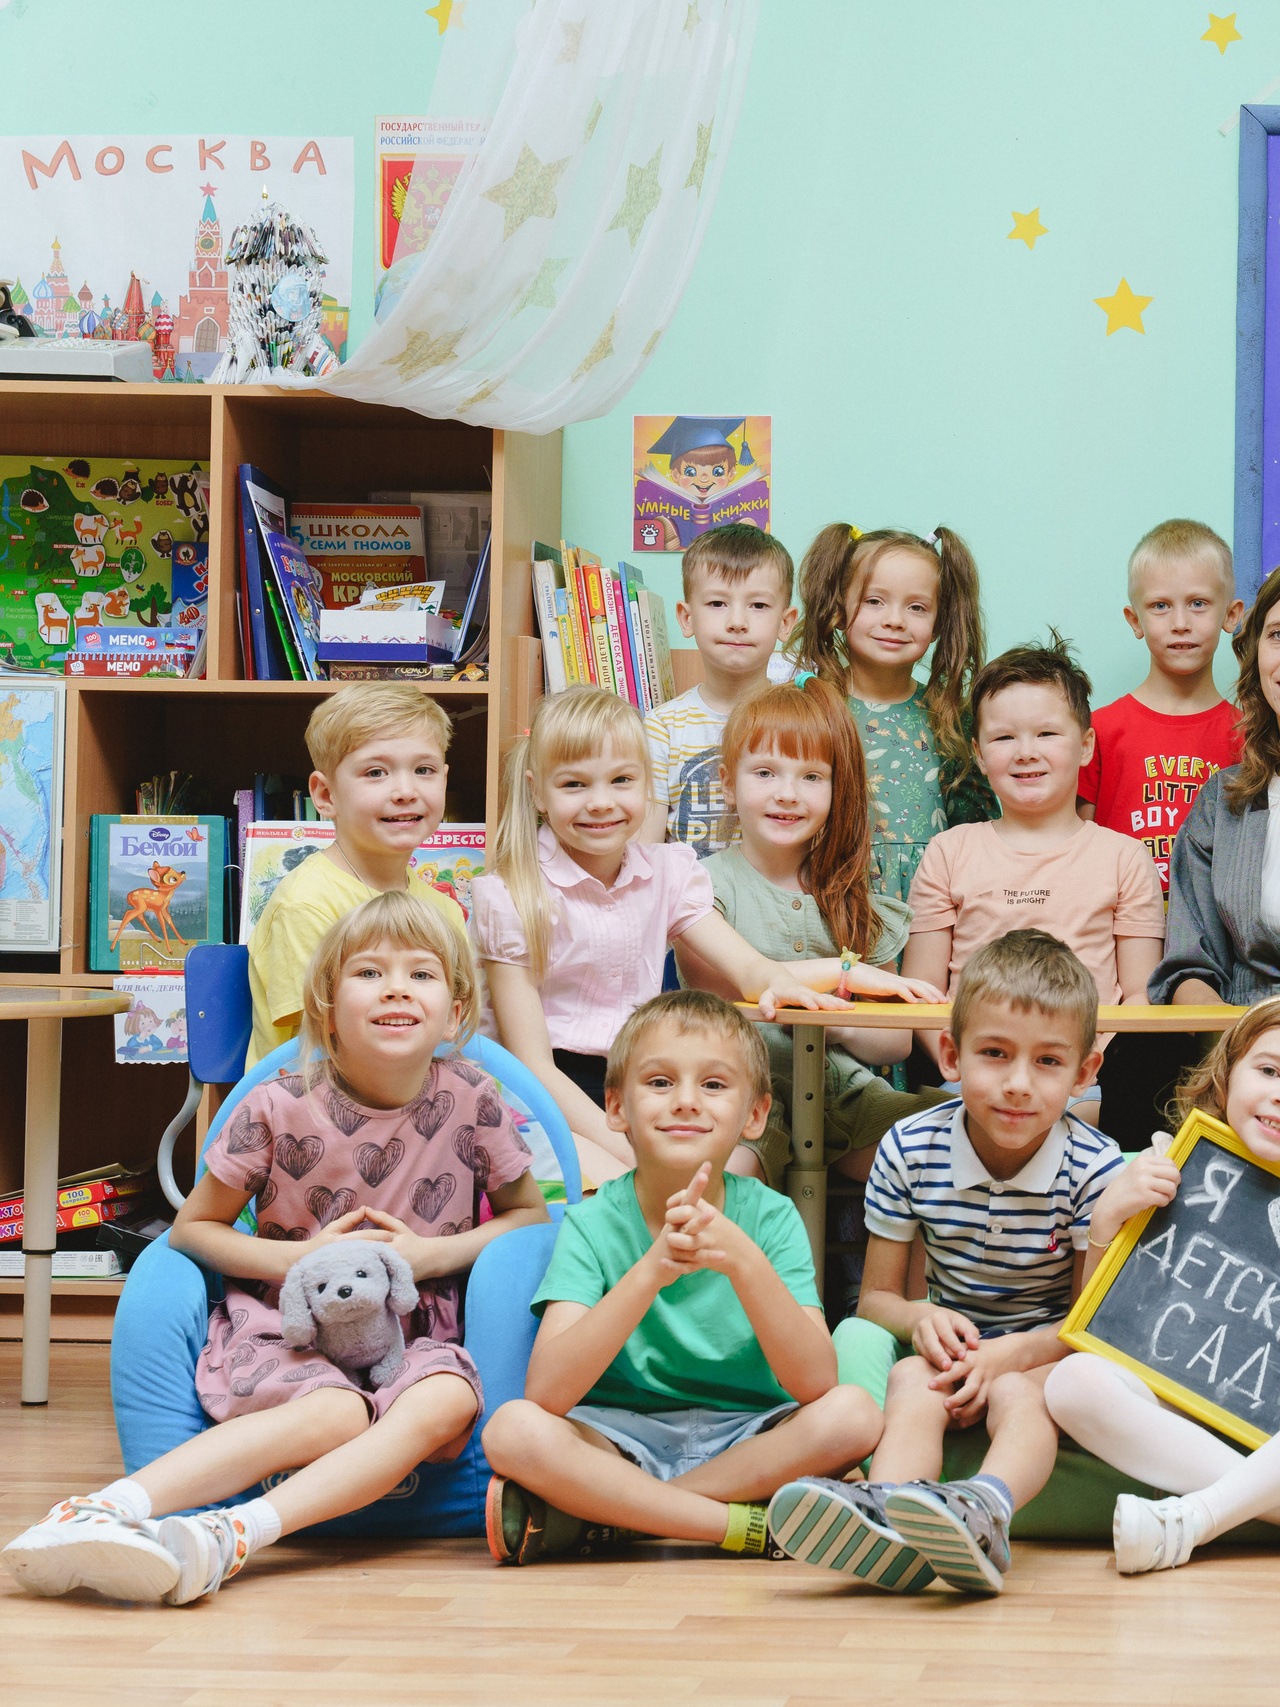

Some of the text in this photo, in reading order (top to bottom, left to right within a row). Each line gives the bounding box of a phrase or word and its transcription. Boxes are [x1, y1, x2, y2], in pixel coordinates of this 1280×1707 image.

[380, 120, 464, 132] ГОСУДАРСТВЕННЫЙ
[380, 133, 435, 145] РОССИЙСКОЙ
[21, 138, 327, 191] МОСКВА
[636, 498, 769, 523] УМНЫЕ КНИЖКИ
[309, 523, 410, 538] ШКОЛА
[309, 540, 347, 551] СЕМИ
[353, 540, 412, 551] ГНОМОВ
[331, 570, 414, 582] МОСКОВСКИЙ
[643, 618, 651, 639] ГОДА
[86, 634, 97, 643] 100
[109, 634, 147, 646] MEMO
[596, 634, 610, 663] ДЕТЕЙ
[610, 624, 623, 673] ДЕТСКАЯ
[106, 661, 141, 672] MEMO
[647, 641, 656, 680] ВРЕМЕНИ
[602, 665, 611, 685] ДЛЯ
[1144, 754, 1221, 780] EVERY
[1142, 780, 1203, 804] LITT
[1130, 806, 1179, 832] BOY
[119, 835, 199, 857] Бемби
[1003, 889, 1051, 897] THE FUTURE
[1016, 897, 1046, 905] BRIGHT
[135, 984, 154, 993] ВАС,
[66, 1189, 85, 1199] 100
[1183, 1159, 1245, 1224] Я
[77, 1209, 91, 1217] 100
[1150, 1301, 1272, 1410] САД
